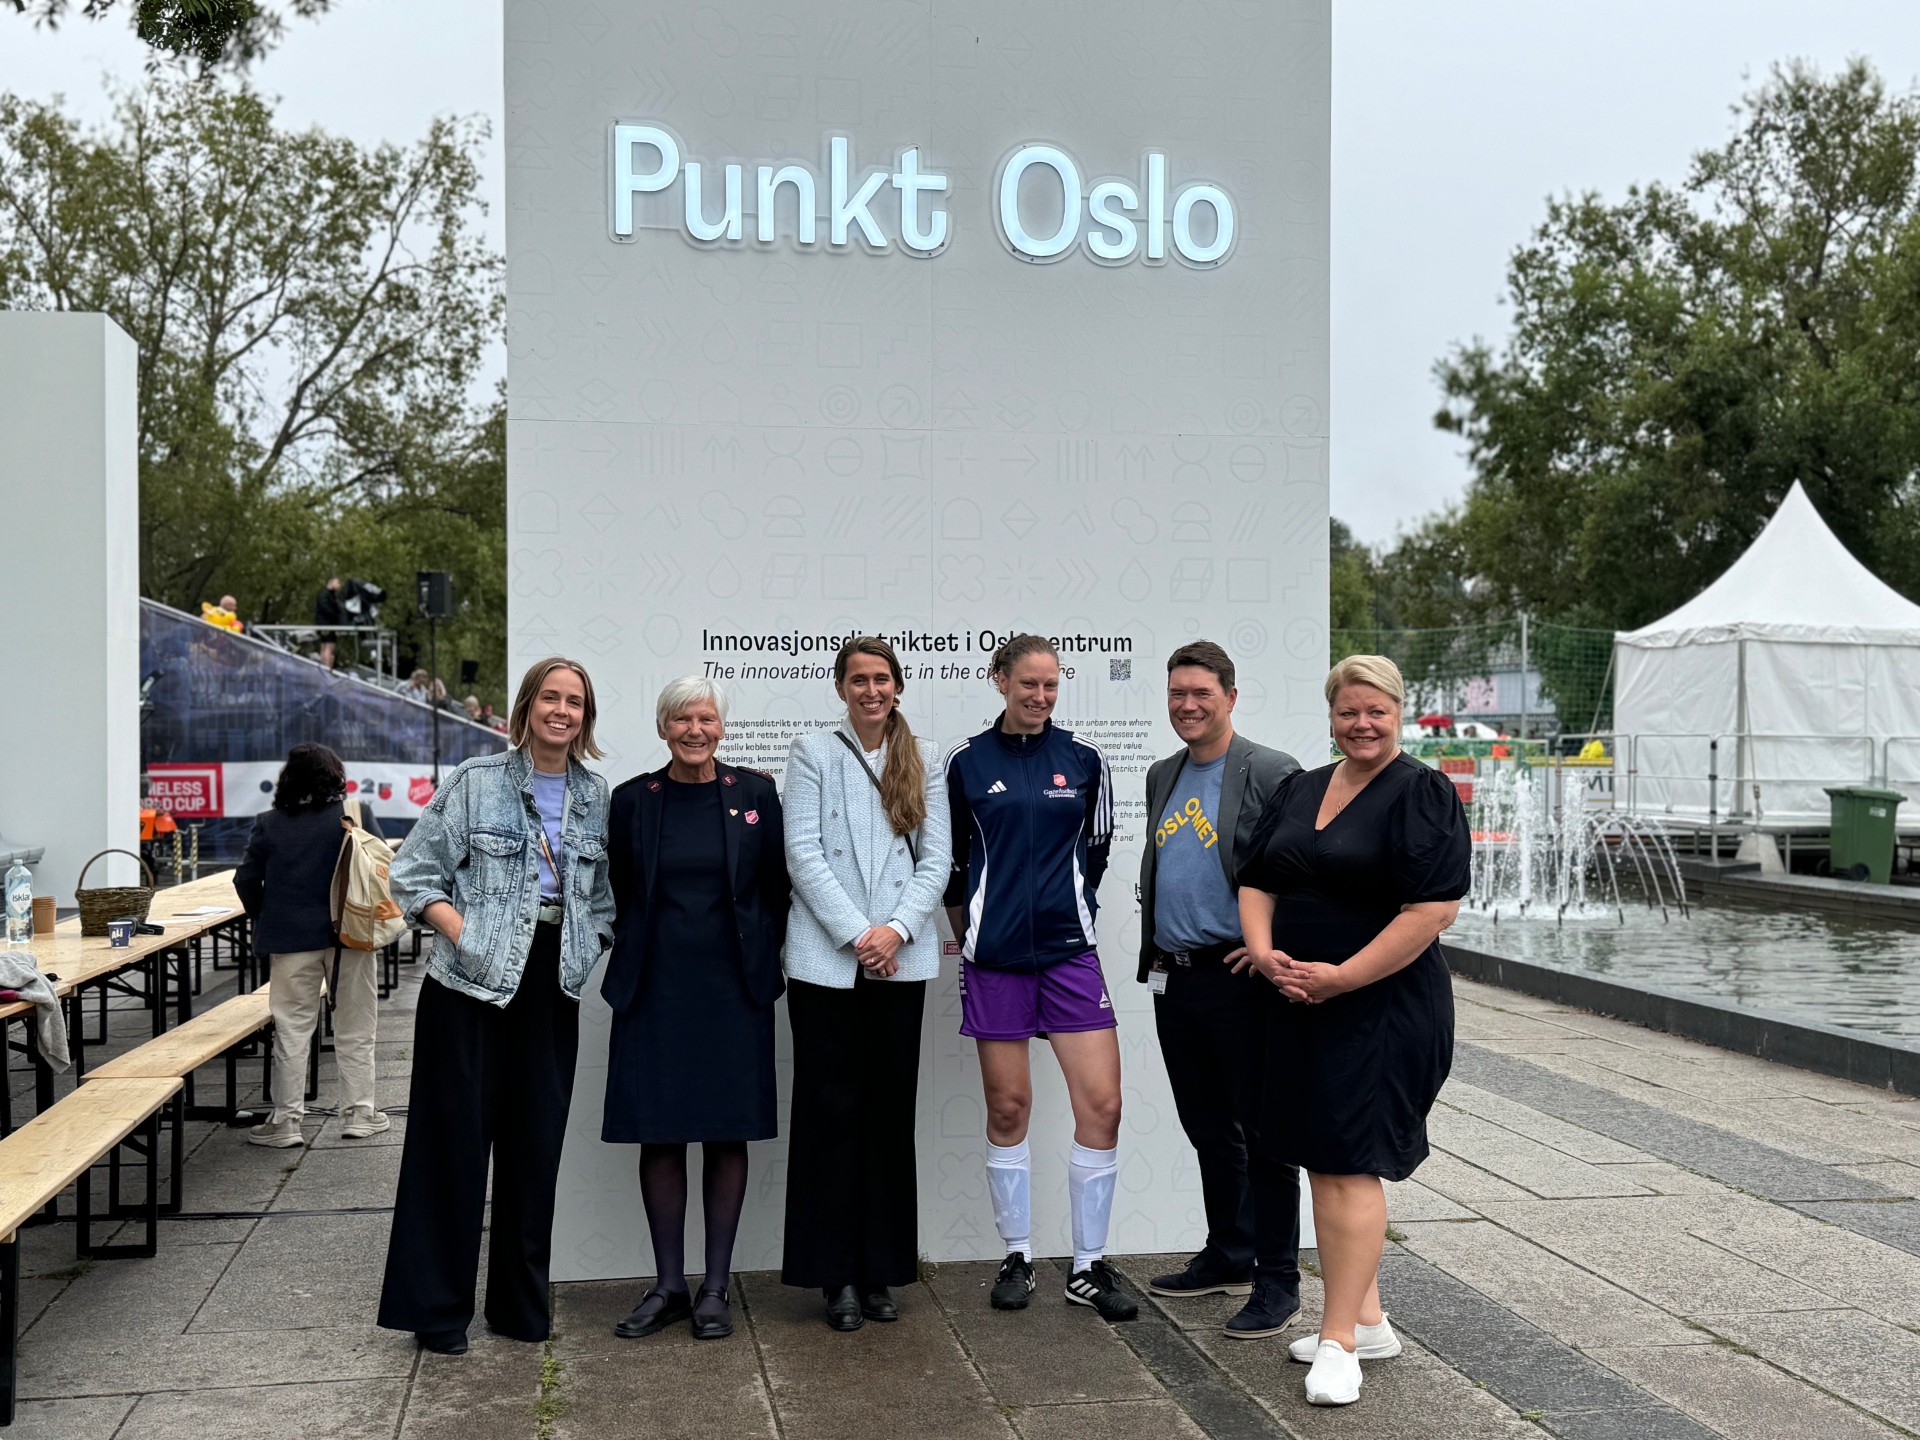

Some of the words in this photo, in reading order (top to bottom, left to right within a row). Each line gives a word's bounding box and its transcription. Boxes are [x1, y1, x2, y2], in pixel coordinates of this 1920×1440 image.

[614, 124, 948, 250] Punkt
[1000, 144, 1236, 262] Oslo
[703, 629, 959, 656] Innovasjonsdtriktet
[966, 631, 971, 652] i
[979, 630, 1014, 652] Os
[1049, 633, 1132, 652] entrum
[703, 662, 735, 679] The
[741, 662, 836, 679] innovation
[918, 663, 934, 679] in
[940, 663, 970, 680] the
[725, 719, 791, 729] ovasjonsdistrikt
[804, 720, 813, 728] et
[982, 719, 993, 727] An
[725, 732, 744, 741] gges
[746, 731, 755, 739] til
[781, 730, 793, 739] for
[718, 743, 744, 753] ingsliv
[1100, 741, 1122, 750] eased
[757, 755, 789, 763] kommer
[148, 781, 203, 797] MELESS
[175, 796, 207, 812] CUP
[1113, 799, 1133, 808] oints
